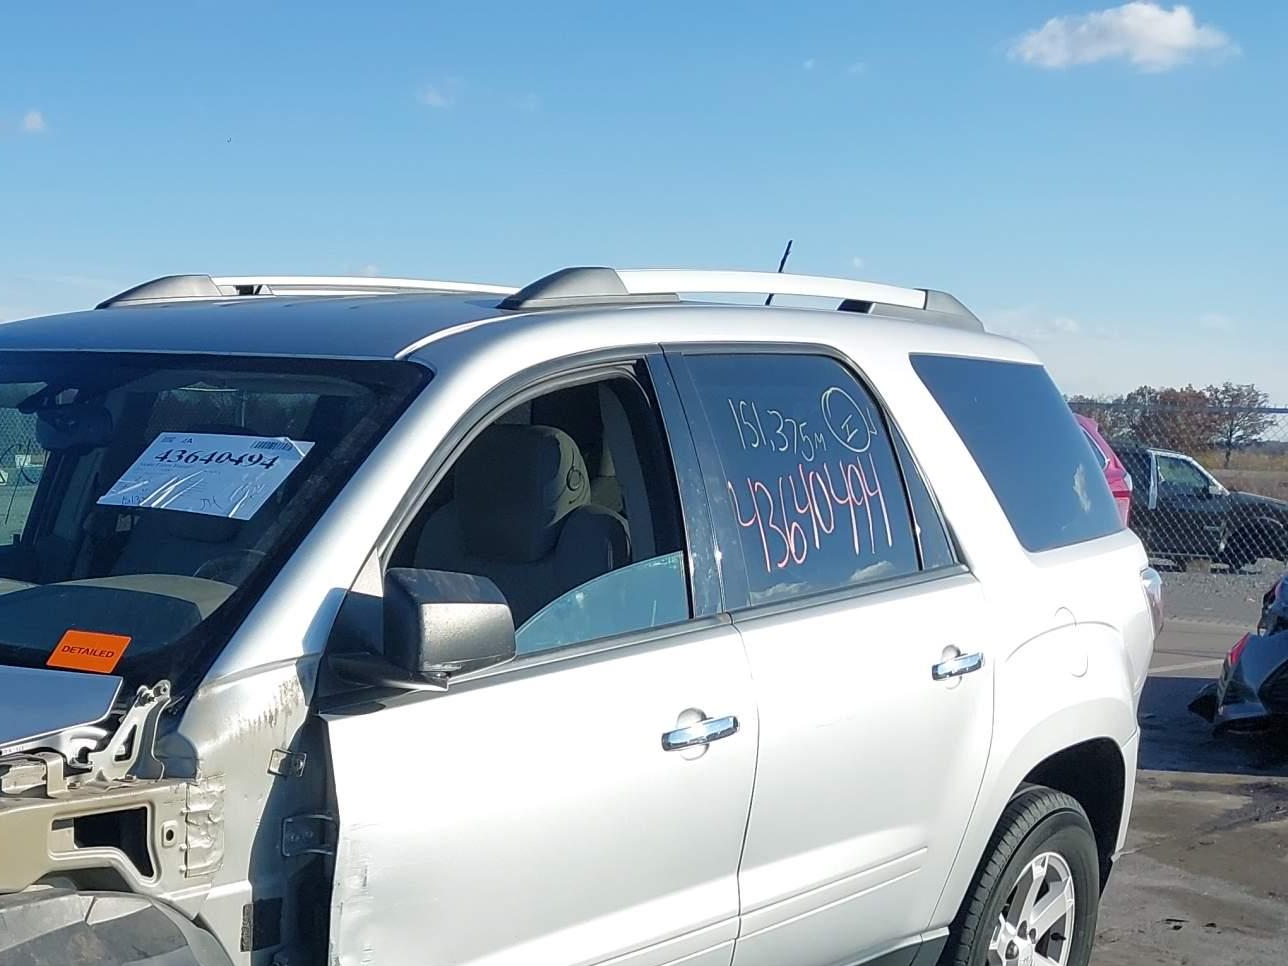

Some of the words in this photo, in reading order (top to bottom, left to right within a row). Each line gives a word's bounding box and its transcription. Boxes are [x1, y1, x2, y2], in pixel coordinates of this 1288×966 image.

[154, 448, 280, 470] 43640494
[727, 453, 893, 574] 43640494
[61, 645, 115, 658] DETAILED
